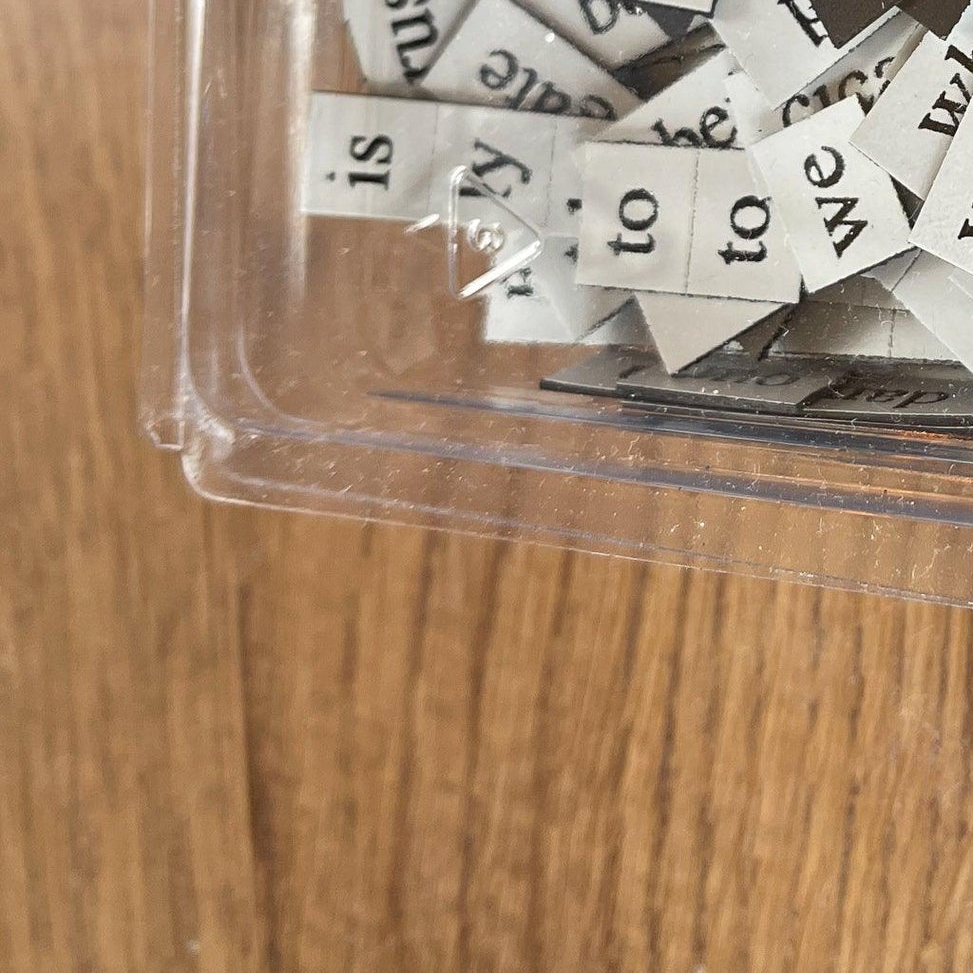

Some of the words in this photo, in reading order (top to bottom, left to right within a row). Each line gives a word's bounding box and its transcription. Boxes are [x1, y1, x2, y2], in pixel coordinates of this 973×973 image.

[325, 133, 394, 191] is
[608, 187, 659, 256] to
[718, 195, 771, 265] to
[804, 145, 869, 259] we
